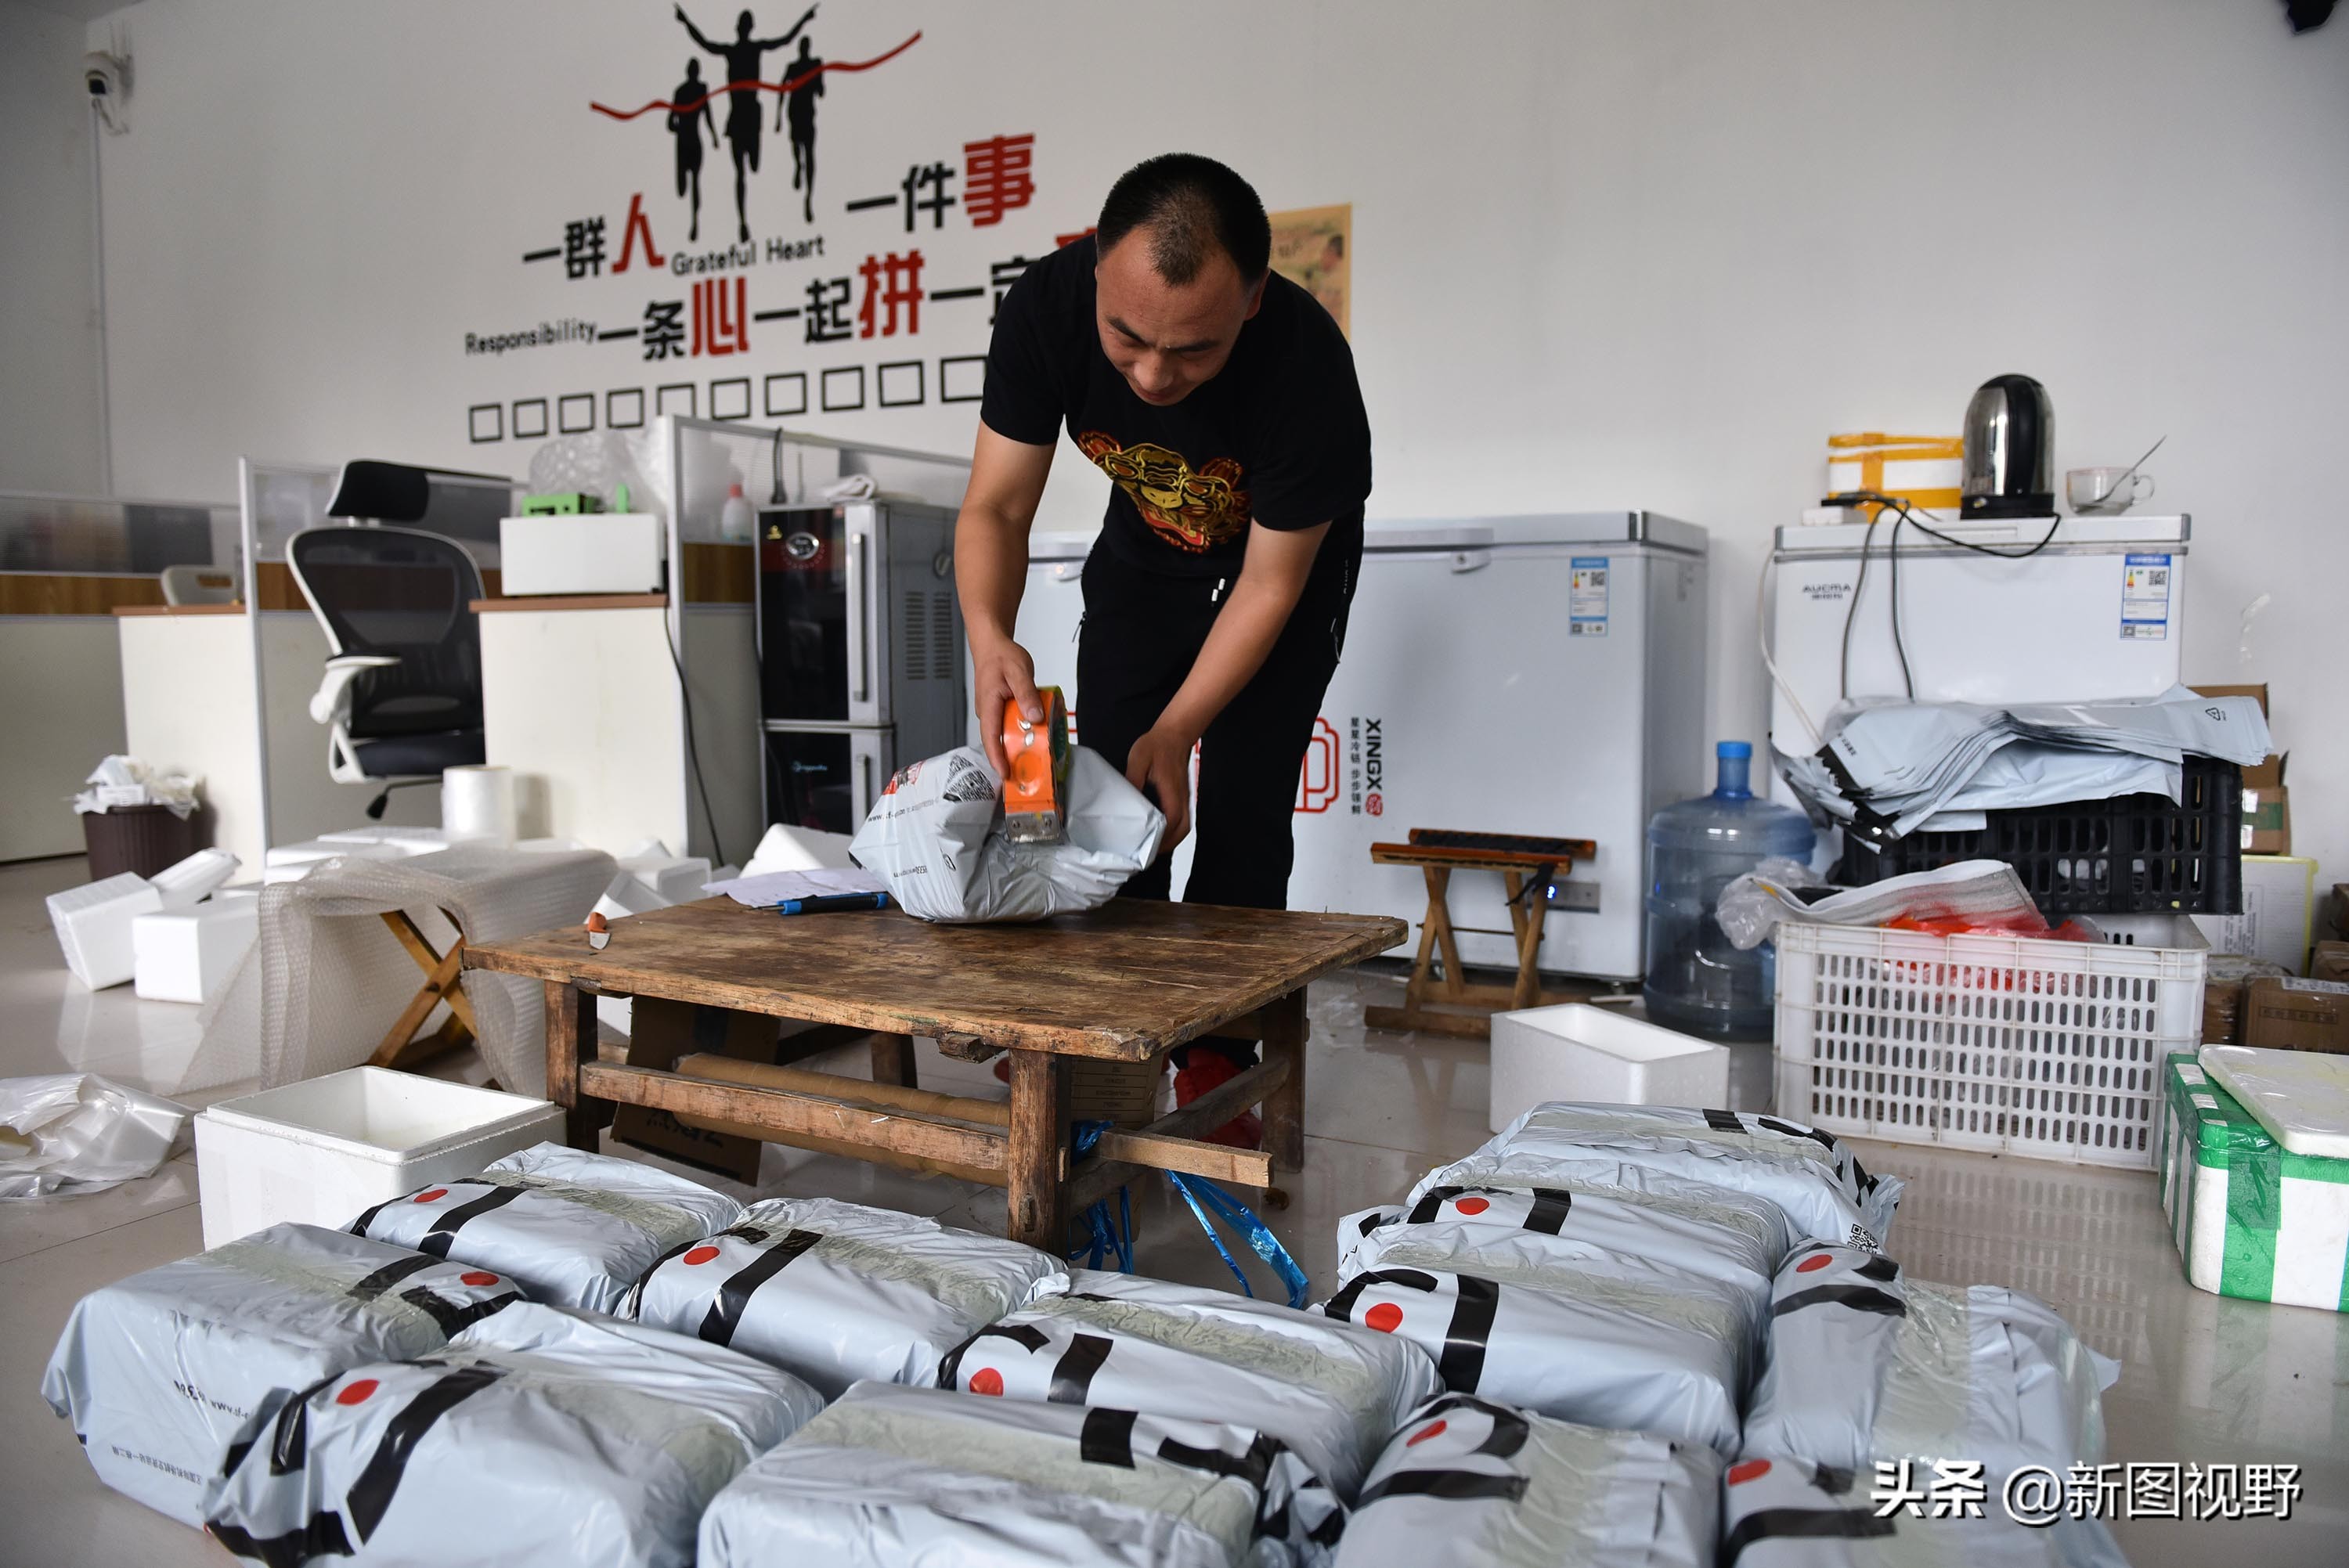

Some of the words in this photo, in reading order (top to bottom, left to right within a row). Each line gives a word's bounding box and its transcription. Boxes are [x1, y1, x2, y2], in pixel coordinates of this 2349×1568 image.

[846, 133, 1035, 233] 一件事
[523, 193, 666, 280] 一群人
[672, 240, 756, 276] Grateful
[766, 236, 825, 264] Heart
[465, 318, 597, 357] Responsibility
[1366, 717, 1383, 792] XINGX
